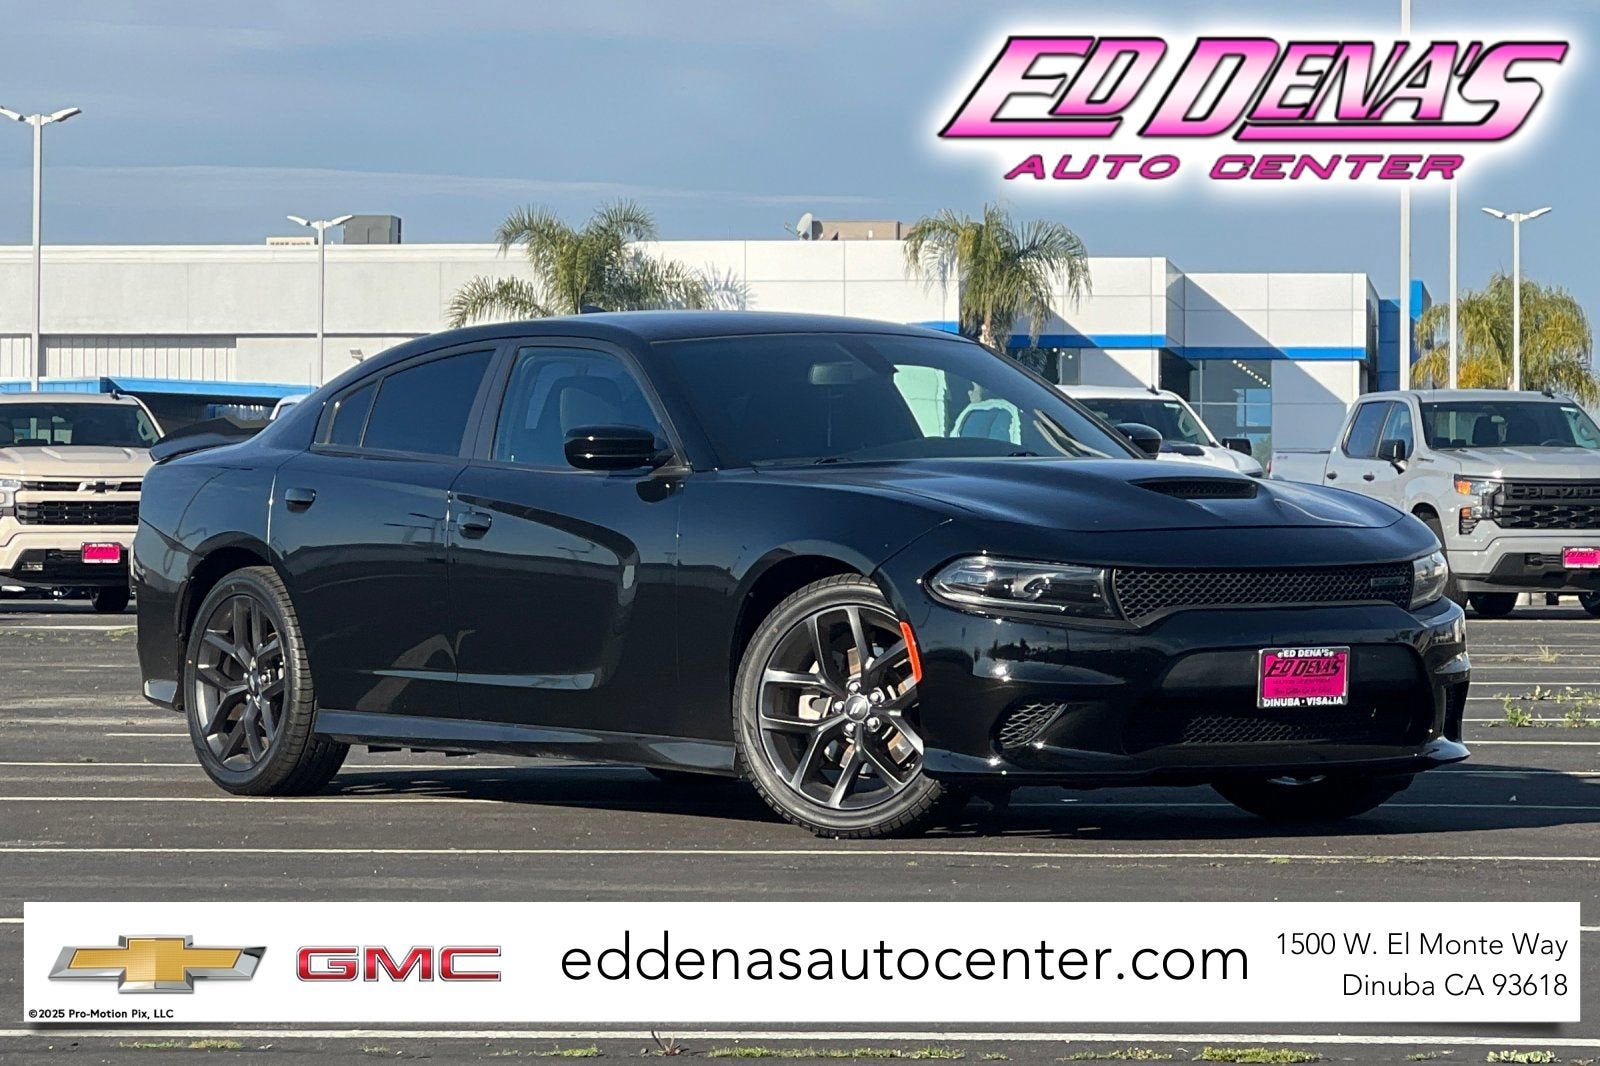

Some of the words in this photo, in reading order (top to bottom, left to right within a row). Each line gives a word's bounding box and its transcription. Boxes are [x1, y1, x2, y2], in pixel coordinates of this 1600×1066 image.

[1284, 649, 1297, 658] ED
[1298, 648, 1330, 658] DENA'S
[1264, 660, 1294, 677] ED
[1263, 698, 1301, 708] DINUBA
[1306, 696, 1344, 706] VISALIA
